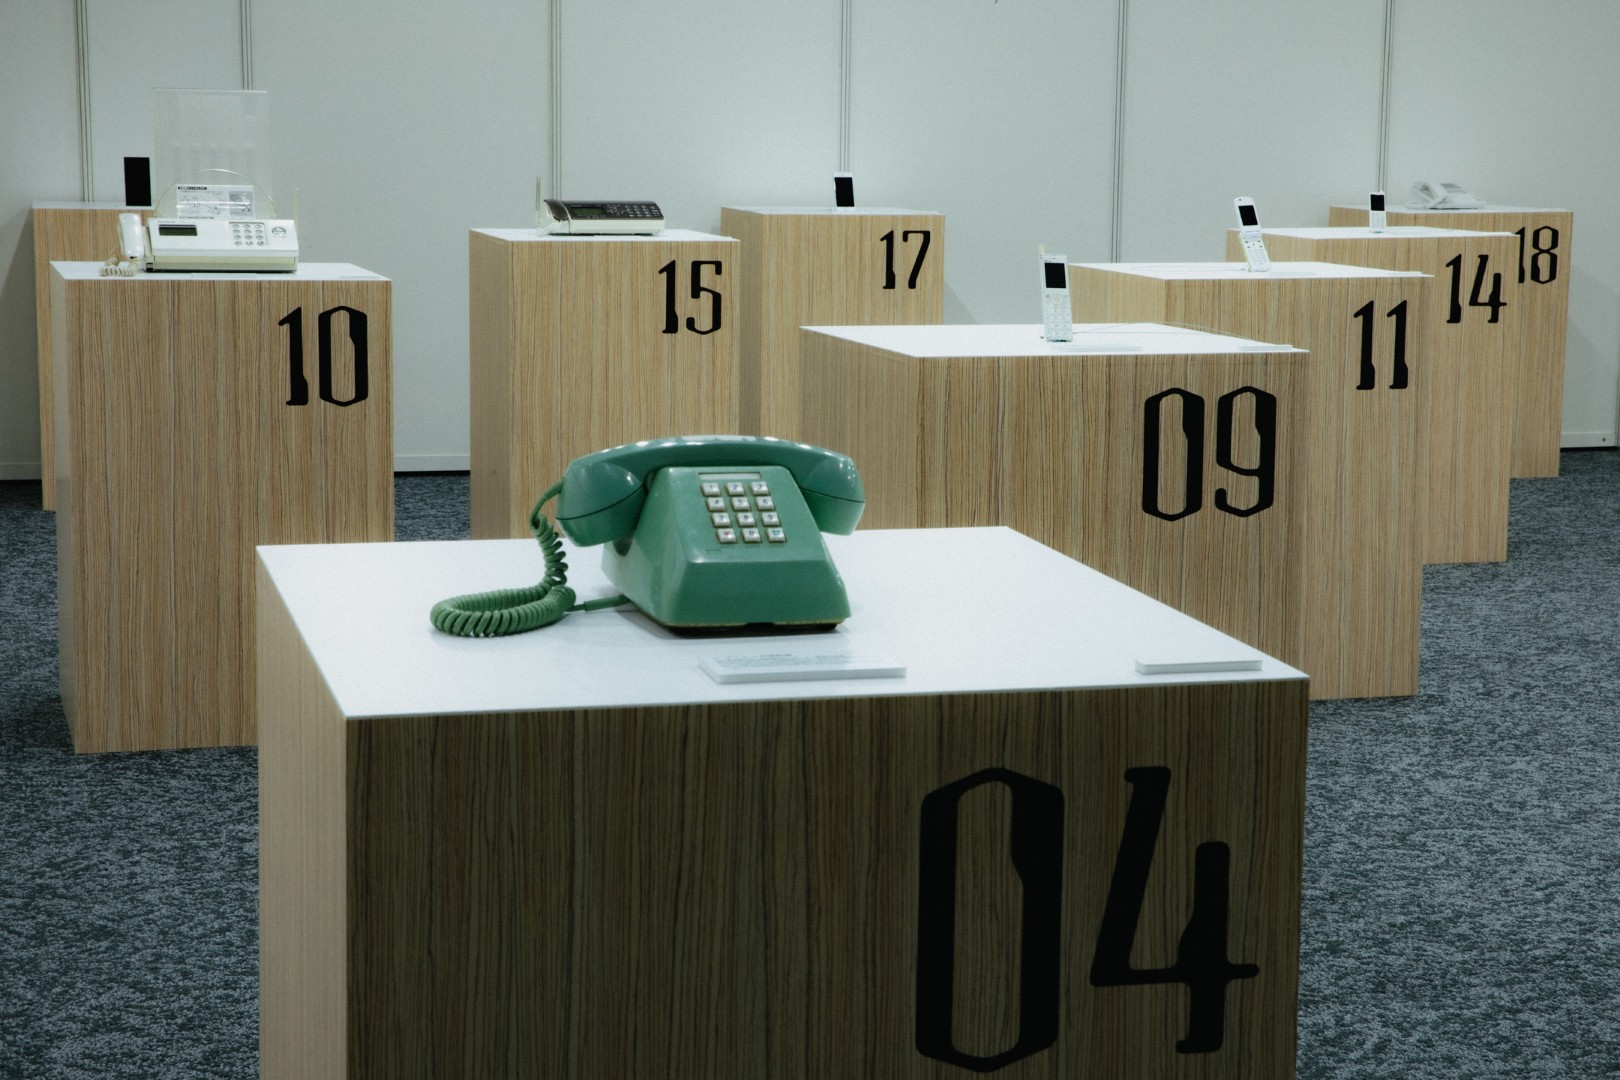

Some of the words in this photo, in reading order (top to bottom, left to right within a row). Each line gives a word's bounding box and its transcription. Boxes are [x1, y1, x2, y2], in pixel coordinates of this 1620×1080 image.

[880, 230, 931, 290] 17
[1445, 254, 1508, 324] 14
[1514, 226, 1559, 285] 18
[658, 260, 723, 335] 15
[278, 306, 369, 407] 10
[1353, 300, 1409, 391] 11
[1141, 386, 1277, 522] 09
[915, 765, 1260, 1074] 04
